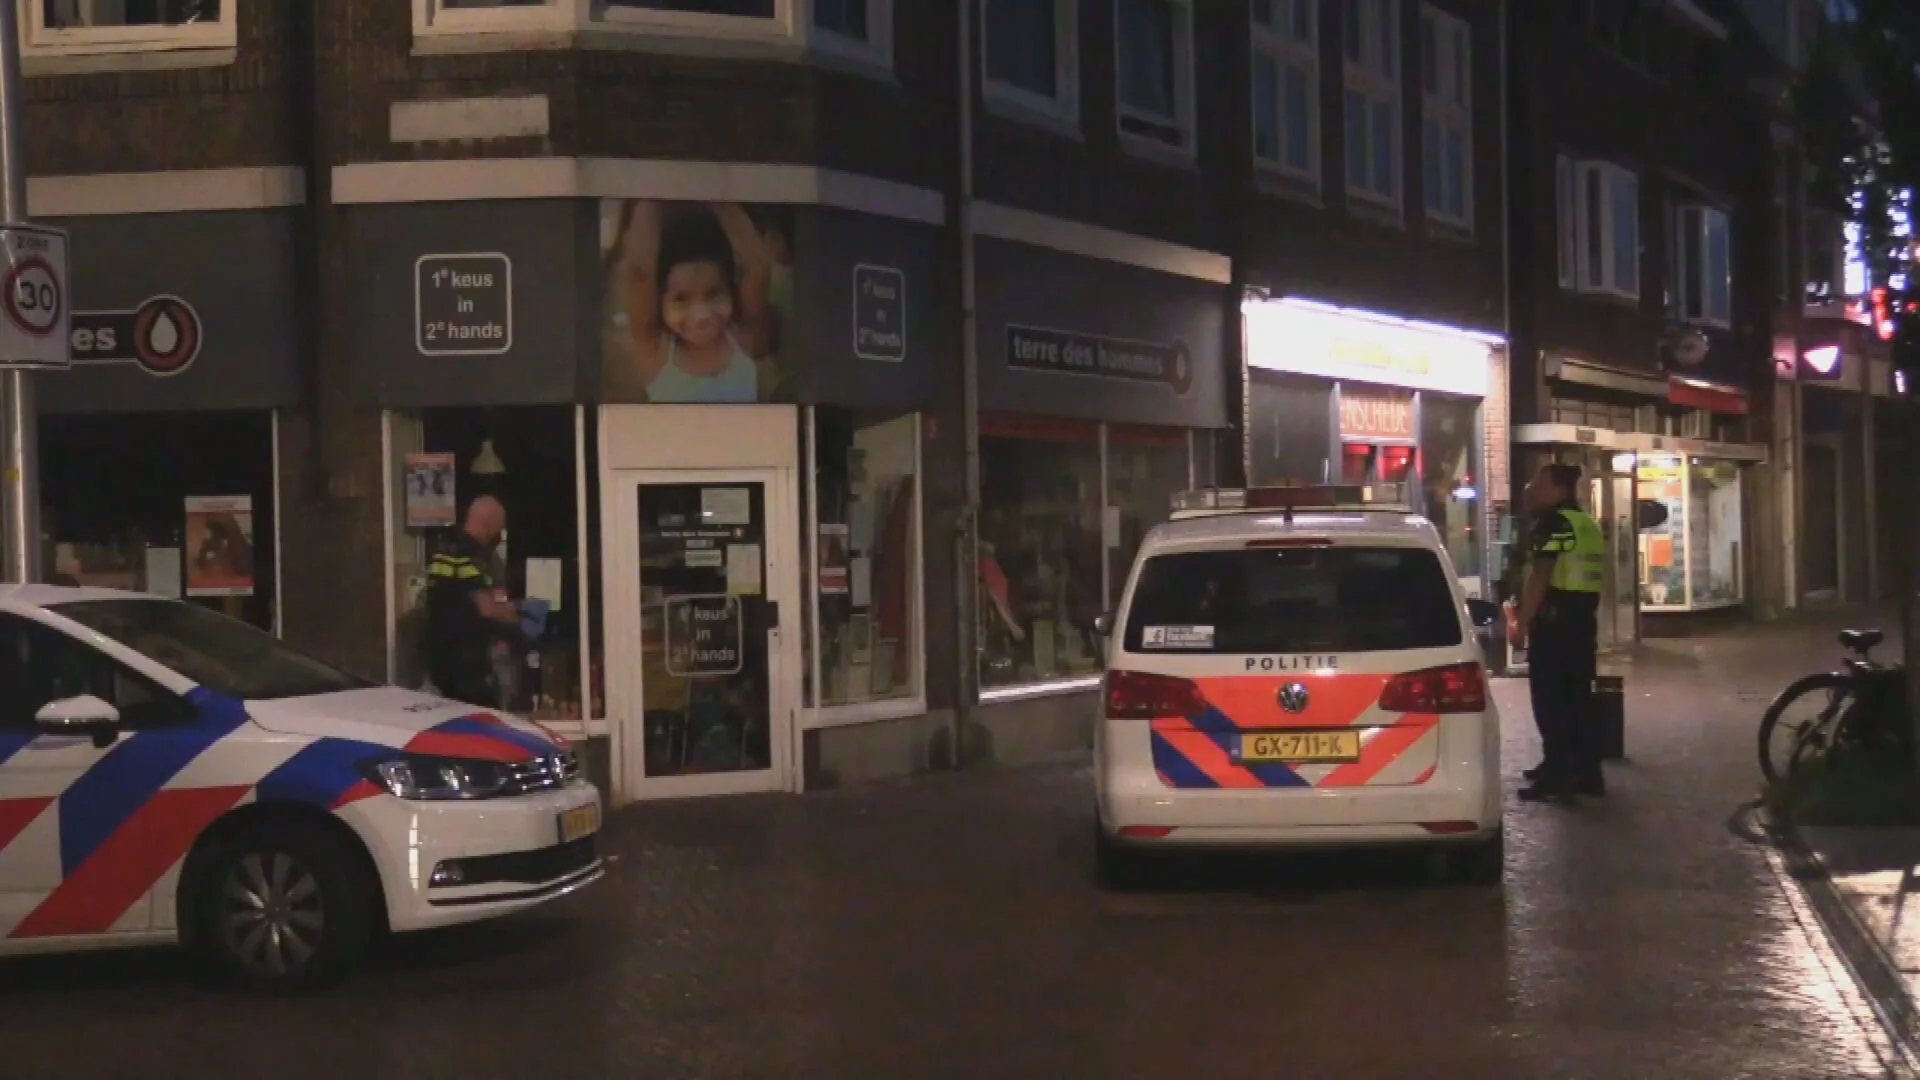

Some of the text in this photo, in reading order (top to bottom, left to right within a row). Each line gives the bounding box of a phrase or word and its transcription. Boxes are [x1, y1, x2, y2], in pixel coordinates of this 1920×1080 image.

[450, 270, 493, 288] keus
[19, 281, 53, 310] 30
[457, 296, 474, 313] in
[447, 320, 502, 339] hands
[1013, 334, 1058, 363] terre
[1063, 339, 1094, 367] des
[690, 645, 736, 663] hands
[1245, 655, 1339, 671] POLITIE
